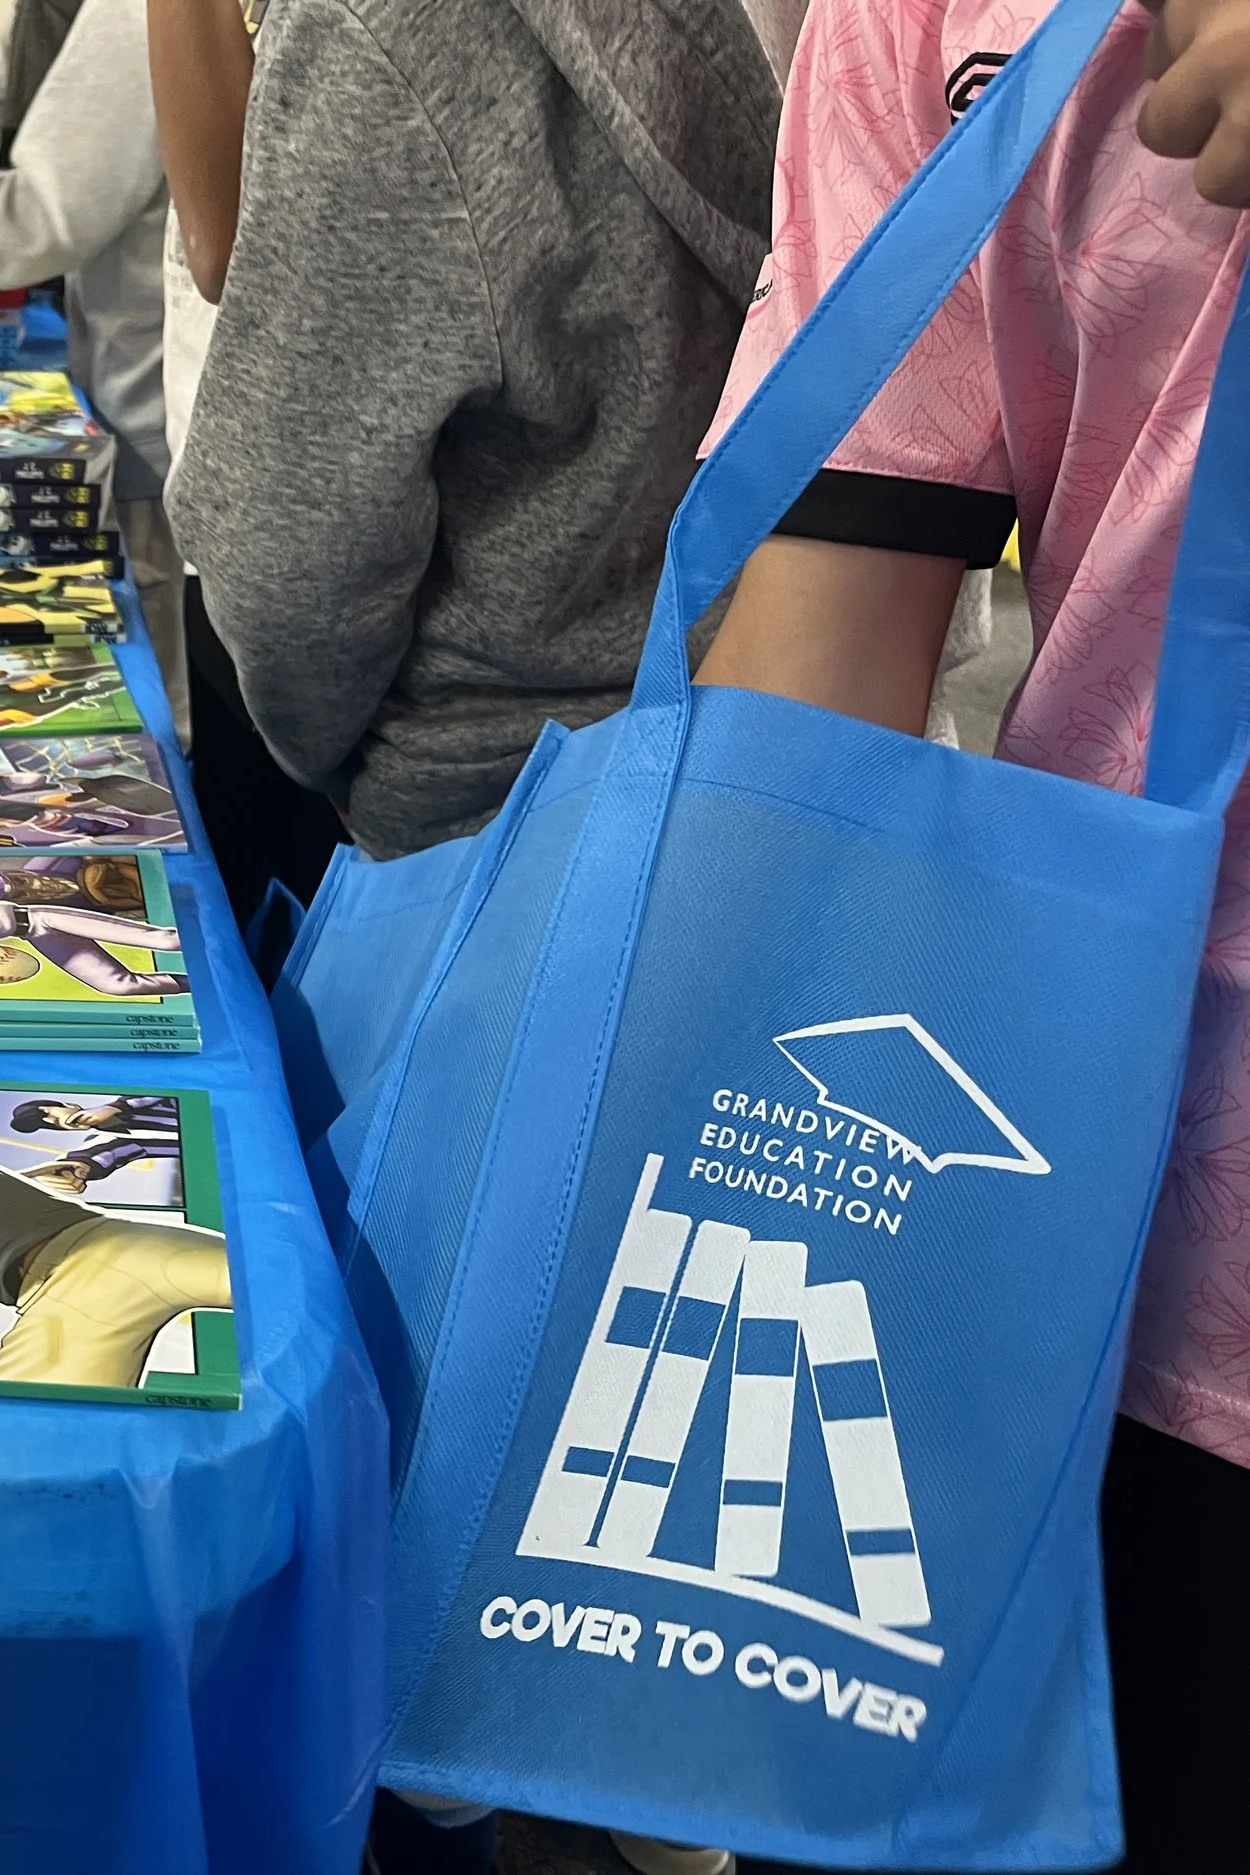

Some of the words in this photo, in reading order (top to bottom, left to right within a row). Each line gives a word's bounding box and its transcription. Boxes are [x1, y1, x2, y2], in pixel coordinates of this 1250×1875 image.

[126, 1013, 174, 1024] capstone
[130, 1027, 177, 1038] capstone
[133, 1040, 180, 1051] capstone
[700, 1123, 912, 1201] EDUCATION
[712, 1088, 922, 1164] GRANDVIEW
[689, 1156, 902, 1235] FOUNDATION
[480, 1596, 642, 1663] COVER
[655, 1620, 724, 1676] TO
[734, 1643, 927, 1742] COVER
